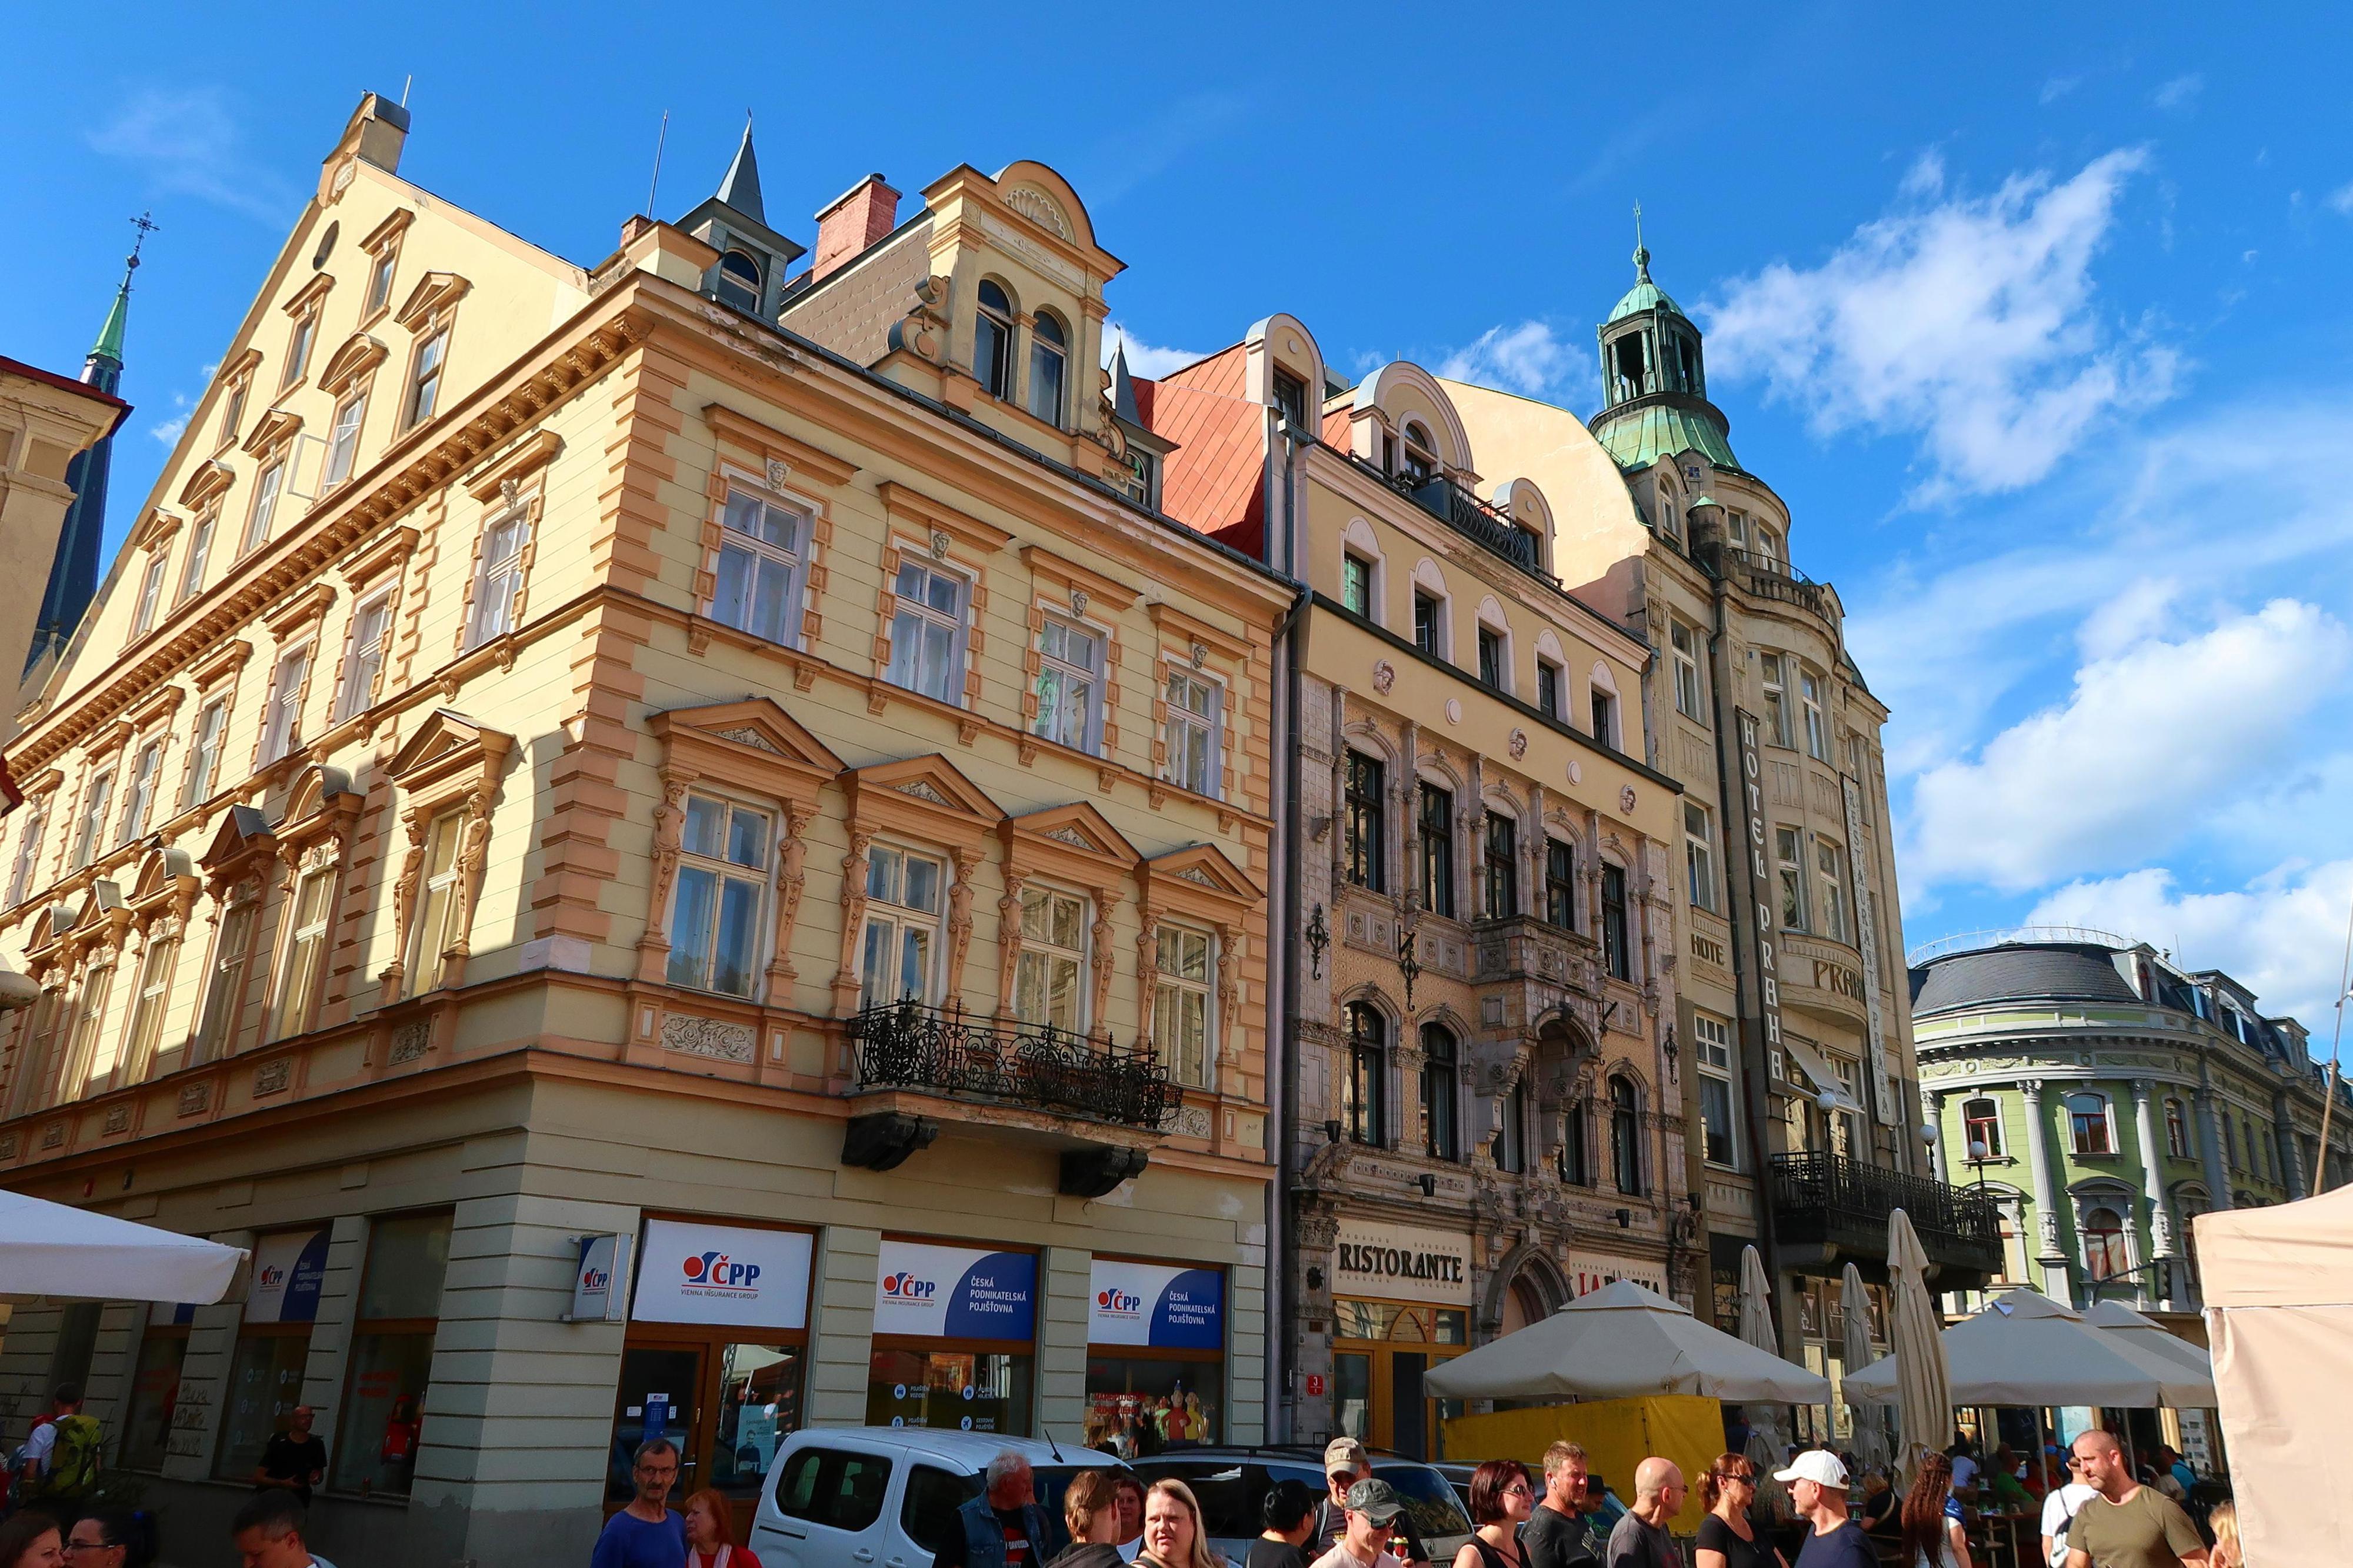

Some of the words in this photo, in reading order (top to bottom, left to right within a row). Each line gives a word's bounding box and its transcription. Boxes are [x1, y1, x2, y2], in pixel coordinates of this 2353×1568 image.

[1743, 718, 1767, 879] HOTEL
[1758, 903, 1784, 1082] PRAHA
[1848, 790, 1875, 987] RESTAURANT
[1872, 1011, 1889, 1115] PRAHA
[1813, 960, 1862, 1002] PRAH
[712, 1255, 761, 1286] ČPP
[1339, 1243, 1464, 1283] RISTORANTE
[903, 1275, 935, 1297] ČPP
[971, 1275, 994, 1287] ČESKÁ
[1579, 1273, 1599, 1296] LA
[705, 1289, 737, 1299] INSURANCE
[970, 1289, 1026, 1302] PODNIKATELSKÁ
[1114, 1290, 1141, 1311] ČPP
[1169, 1290, 1188, 1302] ČESKÁ
[969, 1301, 1013, 1313] POJIŠŤOVNA
[1169, 1303, 1215, 1314] PODNIKATELSKÁ
[1168, 1313, 1205, 1325] POJIŠŤOVNA
[1313, 1376, 1318, 1386] 3
